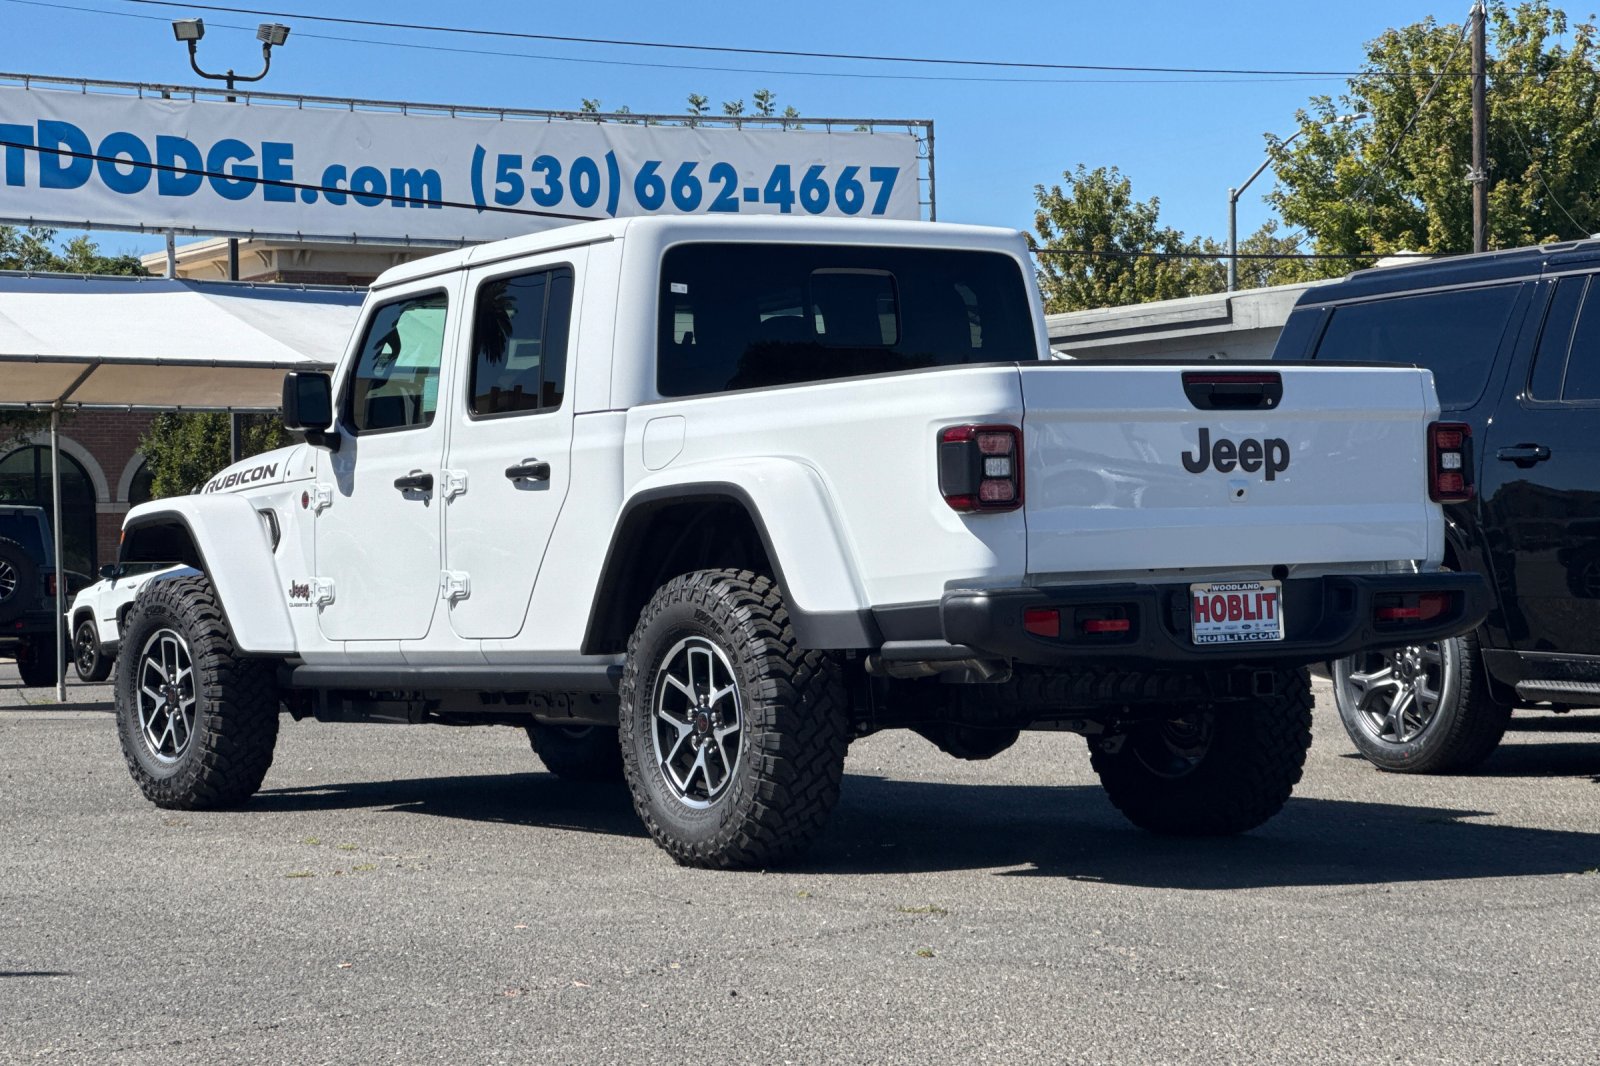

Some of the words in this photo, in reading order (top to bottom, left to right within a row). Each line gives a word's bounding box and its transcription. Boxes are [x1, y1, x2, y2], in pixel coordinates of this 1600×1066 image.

[470, 143, 621, 218] (530)
[633, 160, 900, 216] 662-4667
[1181, 427, 1291, 481] Jeep
[205, 463, 279, 494] RUBICON
[289, 579, 310, 601] Jeep
[1211, 583, 1259, 591] WOODLAND
[1194, 593, 1277, 623] HOBLIT
[1197, 632, 1280, 643] HOBLIT.COM
